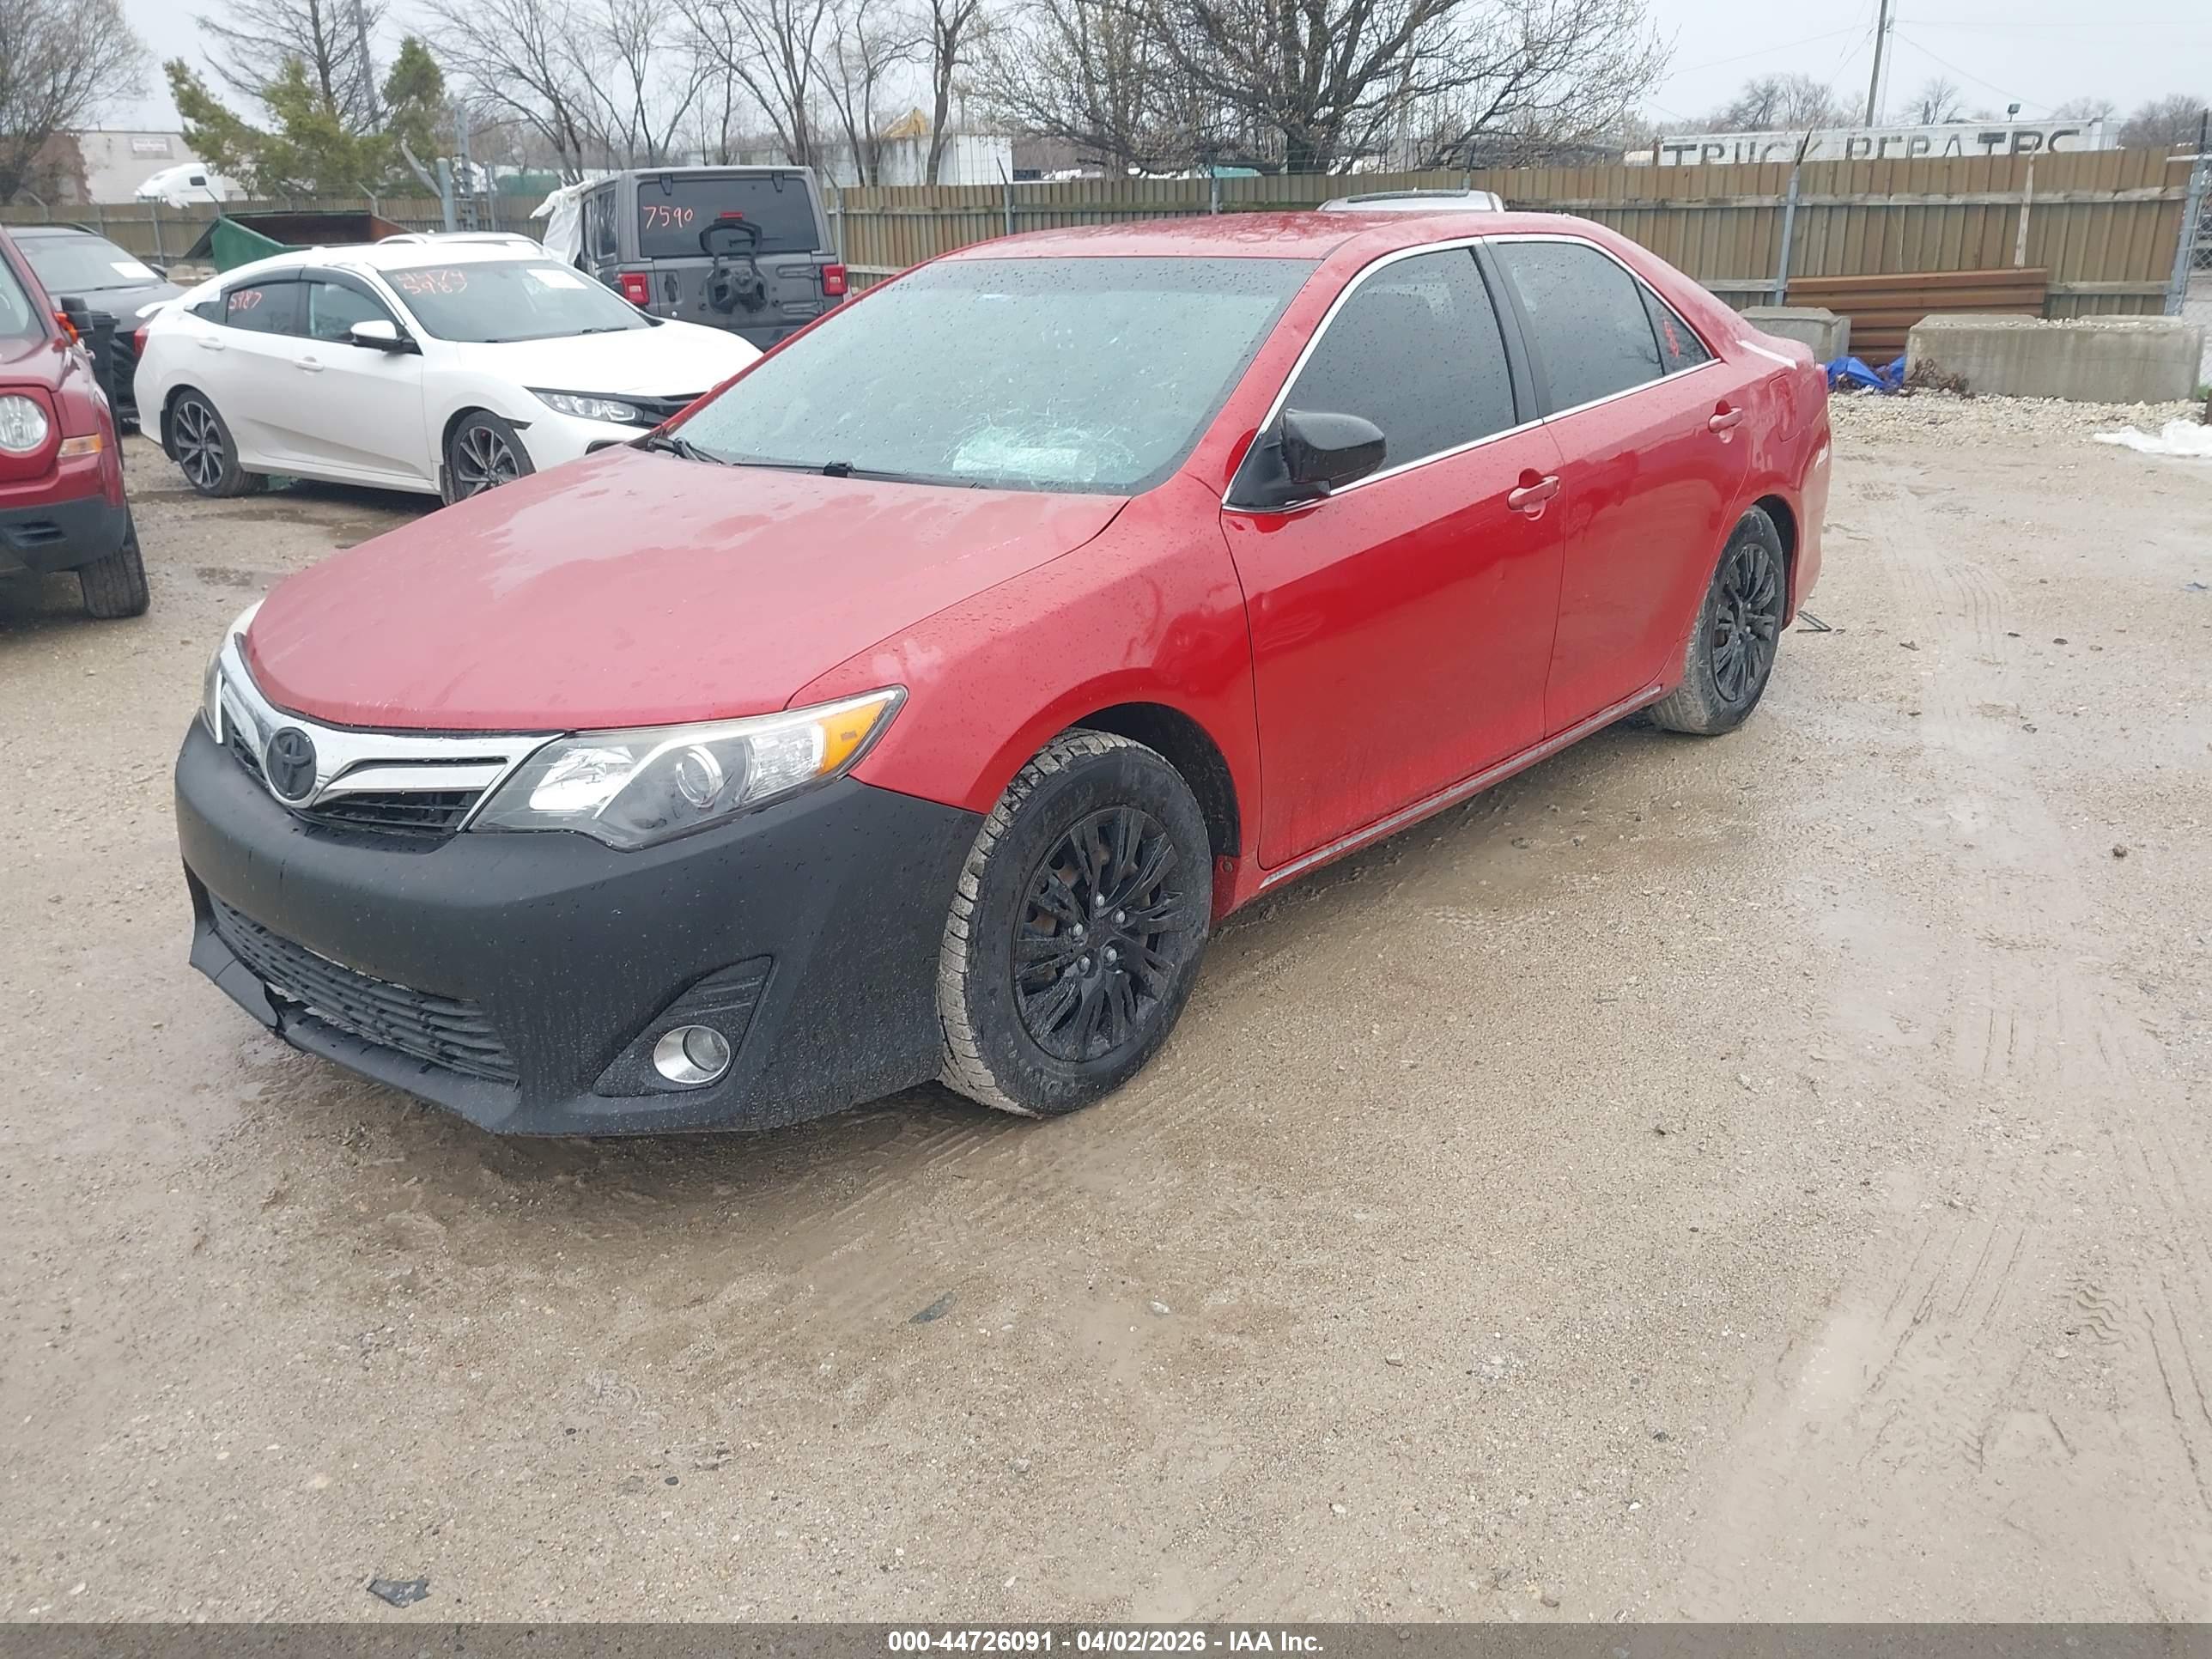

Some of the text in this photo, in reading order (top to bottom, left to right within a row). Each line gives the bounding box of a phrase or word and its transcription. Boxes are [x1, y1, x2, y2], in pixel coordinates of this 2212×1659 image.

[642, 206, 694, 229] 7590
[404, 281, 468, 295] 5987
[228, 289, 262, 310] 5987
